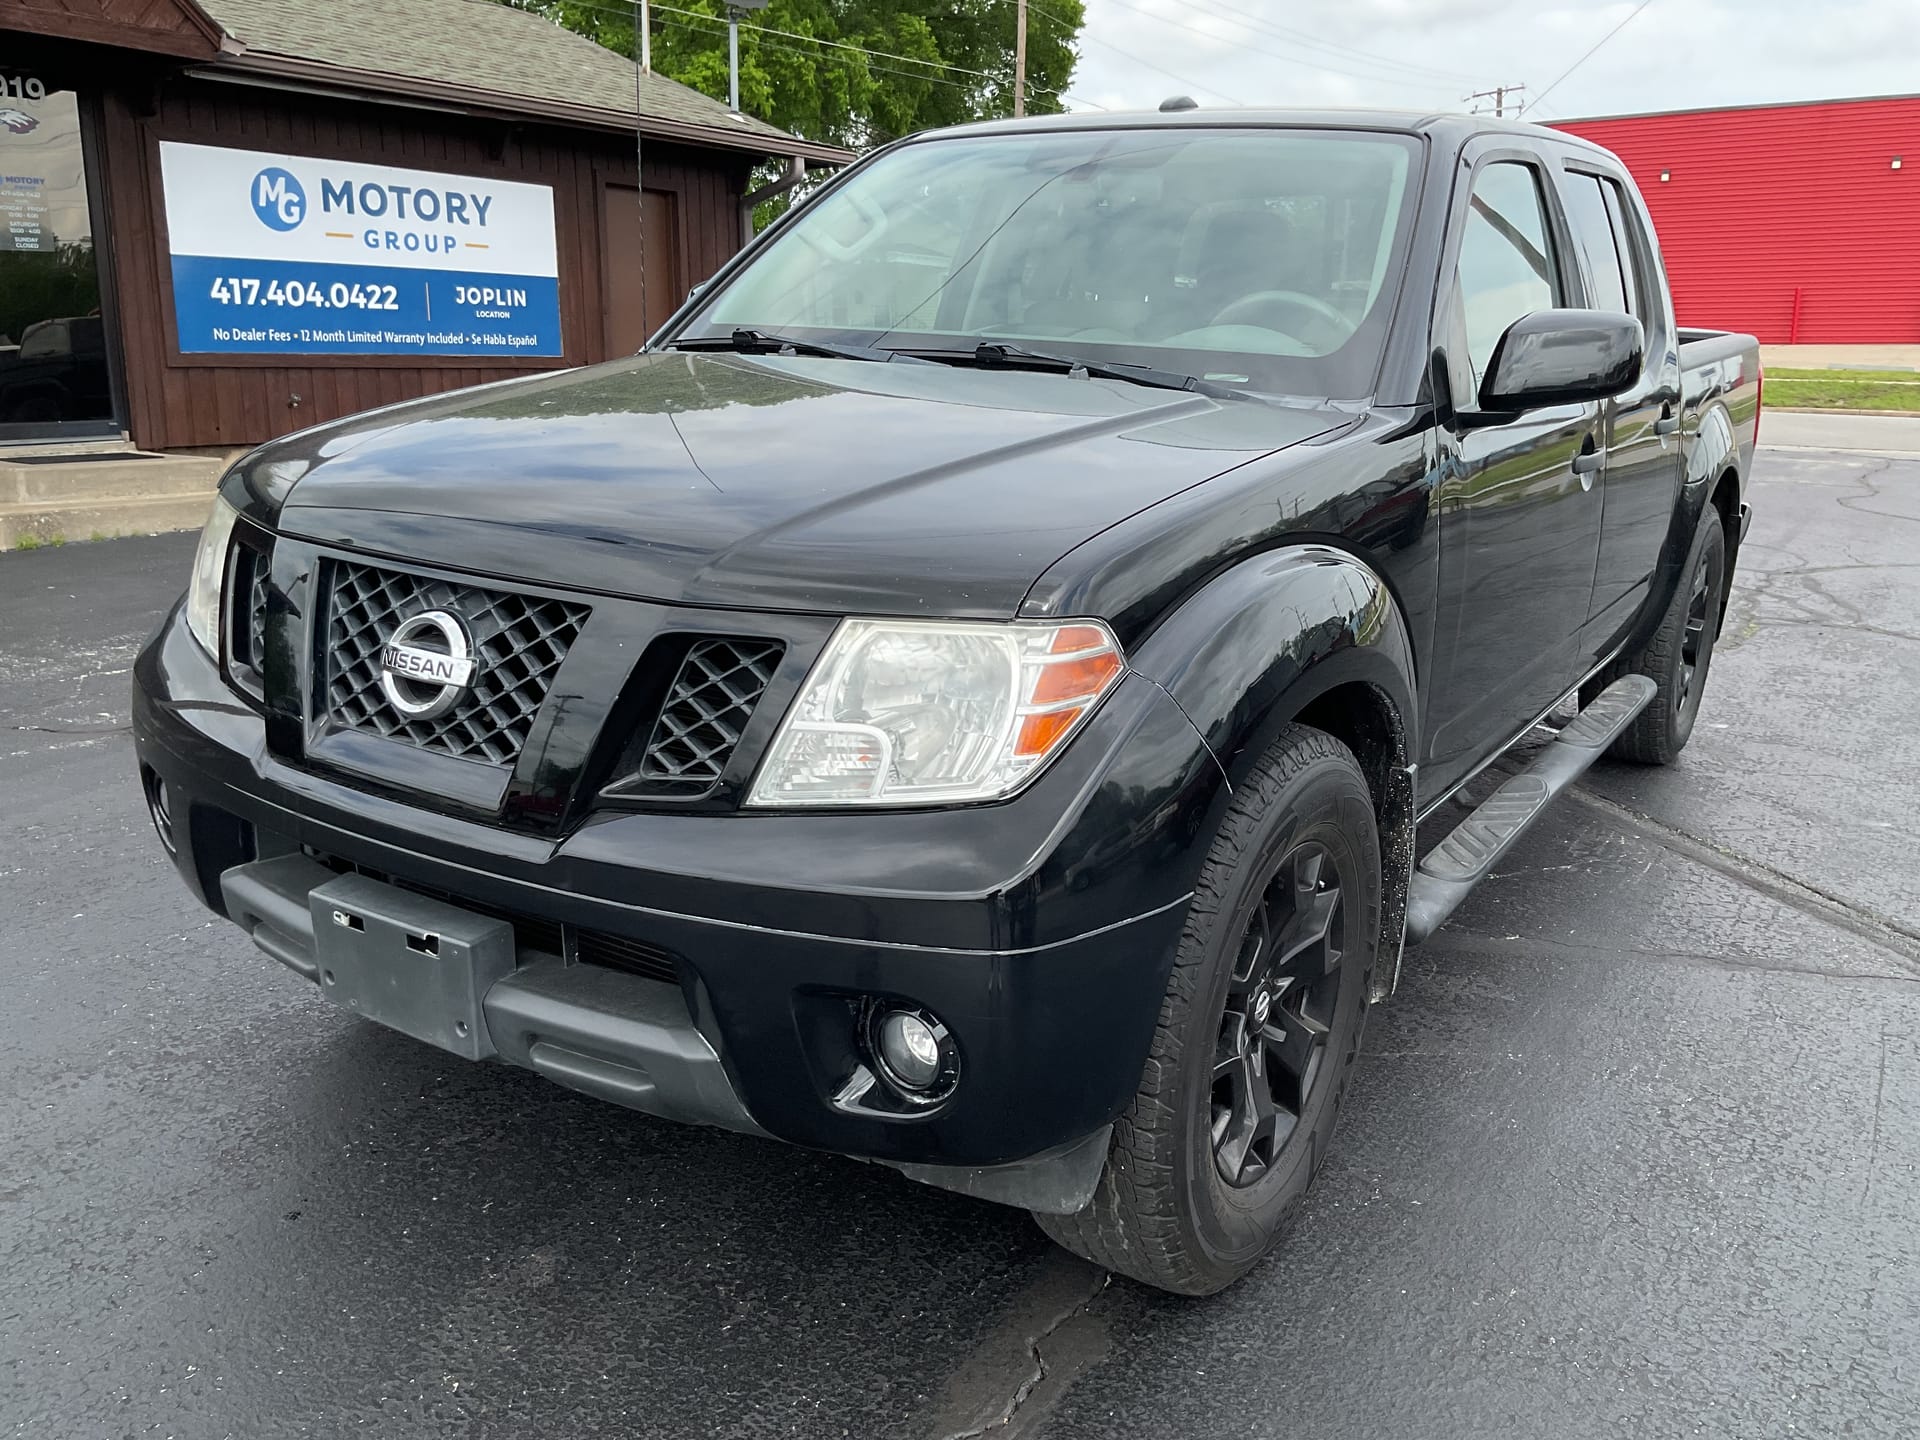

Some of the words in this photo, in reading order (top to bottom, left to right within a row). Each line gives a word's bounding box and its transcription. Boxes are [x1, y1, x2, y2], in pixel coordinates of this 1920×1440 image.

[5, 176, 45, 185] MOTORY
[321, 178, 492, 226] MOTORY
[364, 229, 457, 254] GROUP
[210, 277, 399, 310] 417.404.0422
[455, 286, 527, 308] JOPLIN
[476, 310, 511, 319] LOCATION
[213, 328, 230, 341] No
[232, 328, 266, 341] Dealer
[269, 329, 291, 342] Fees
[301, 329, 311, 342] 12
[313, 330, 345, 342] Month
[347, 330, 382, 343] Limited
[384, 331, 425, 346] Warranty
[427, 332, 464, 345] Included
[471, 334, 482, 345] Se
[484, 333, 506, 345] Habla
[509, 334, 537, 348] Español
[382, 648, 454, 679] NISSAN
